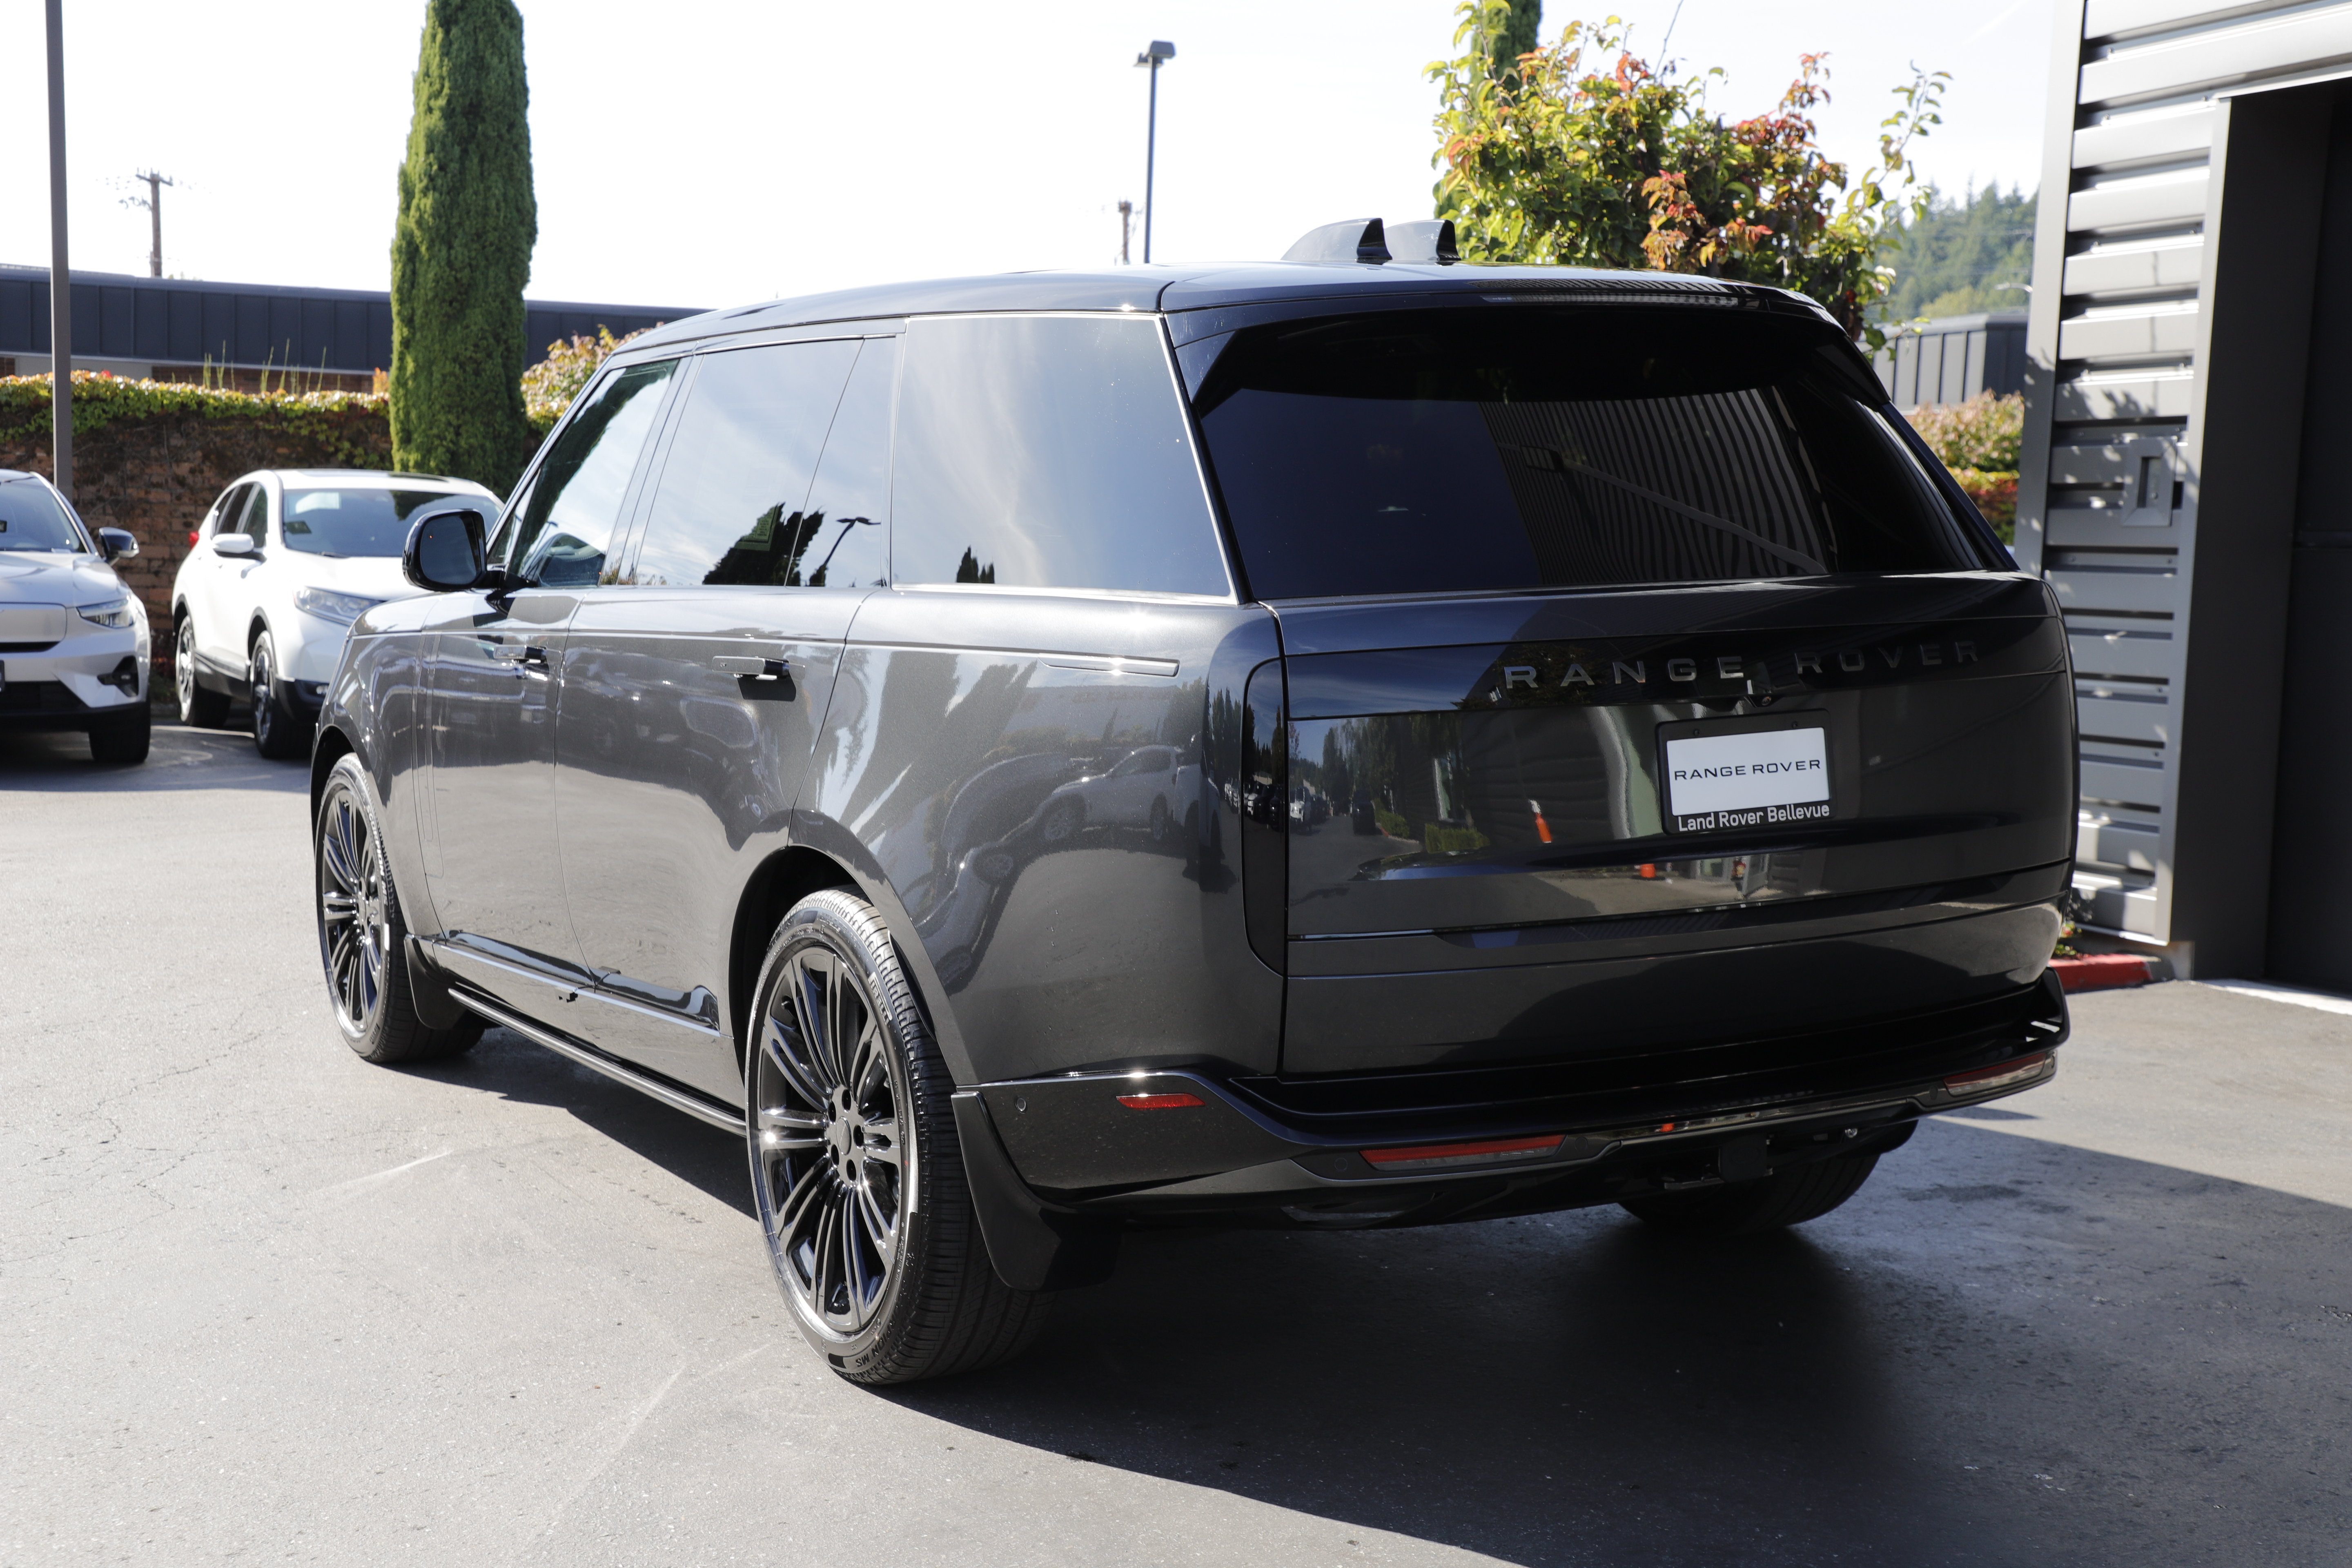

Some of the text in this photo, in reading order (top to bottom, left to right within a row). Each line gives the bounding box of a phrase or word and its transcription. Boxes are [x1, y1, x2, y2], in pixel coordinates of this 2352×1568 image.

[1504, 641, 1978, 689] RANGE ROVER
[1674, 760, 1821, 780] RANGE ROVER
[1678, 804, 1830, 831] Land Rover Bellevue
[868, 971, 893, 1026] PIRELLI
[855, 1354, 870, 1367] MS
